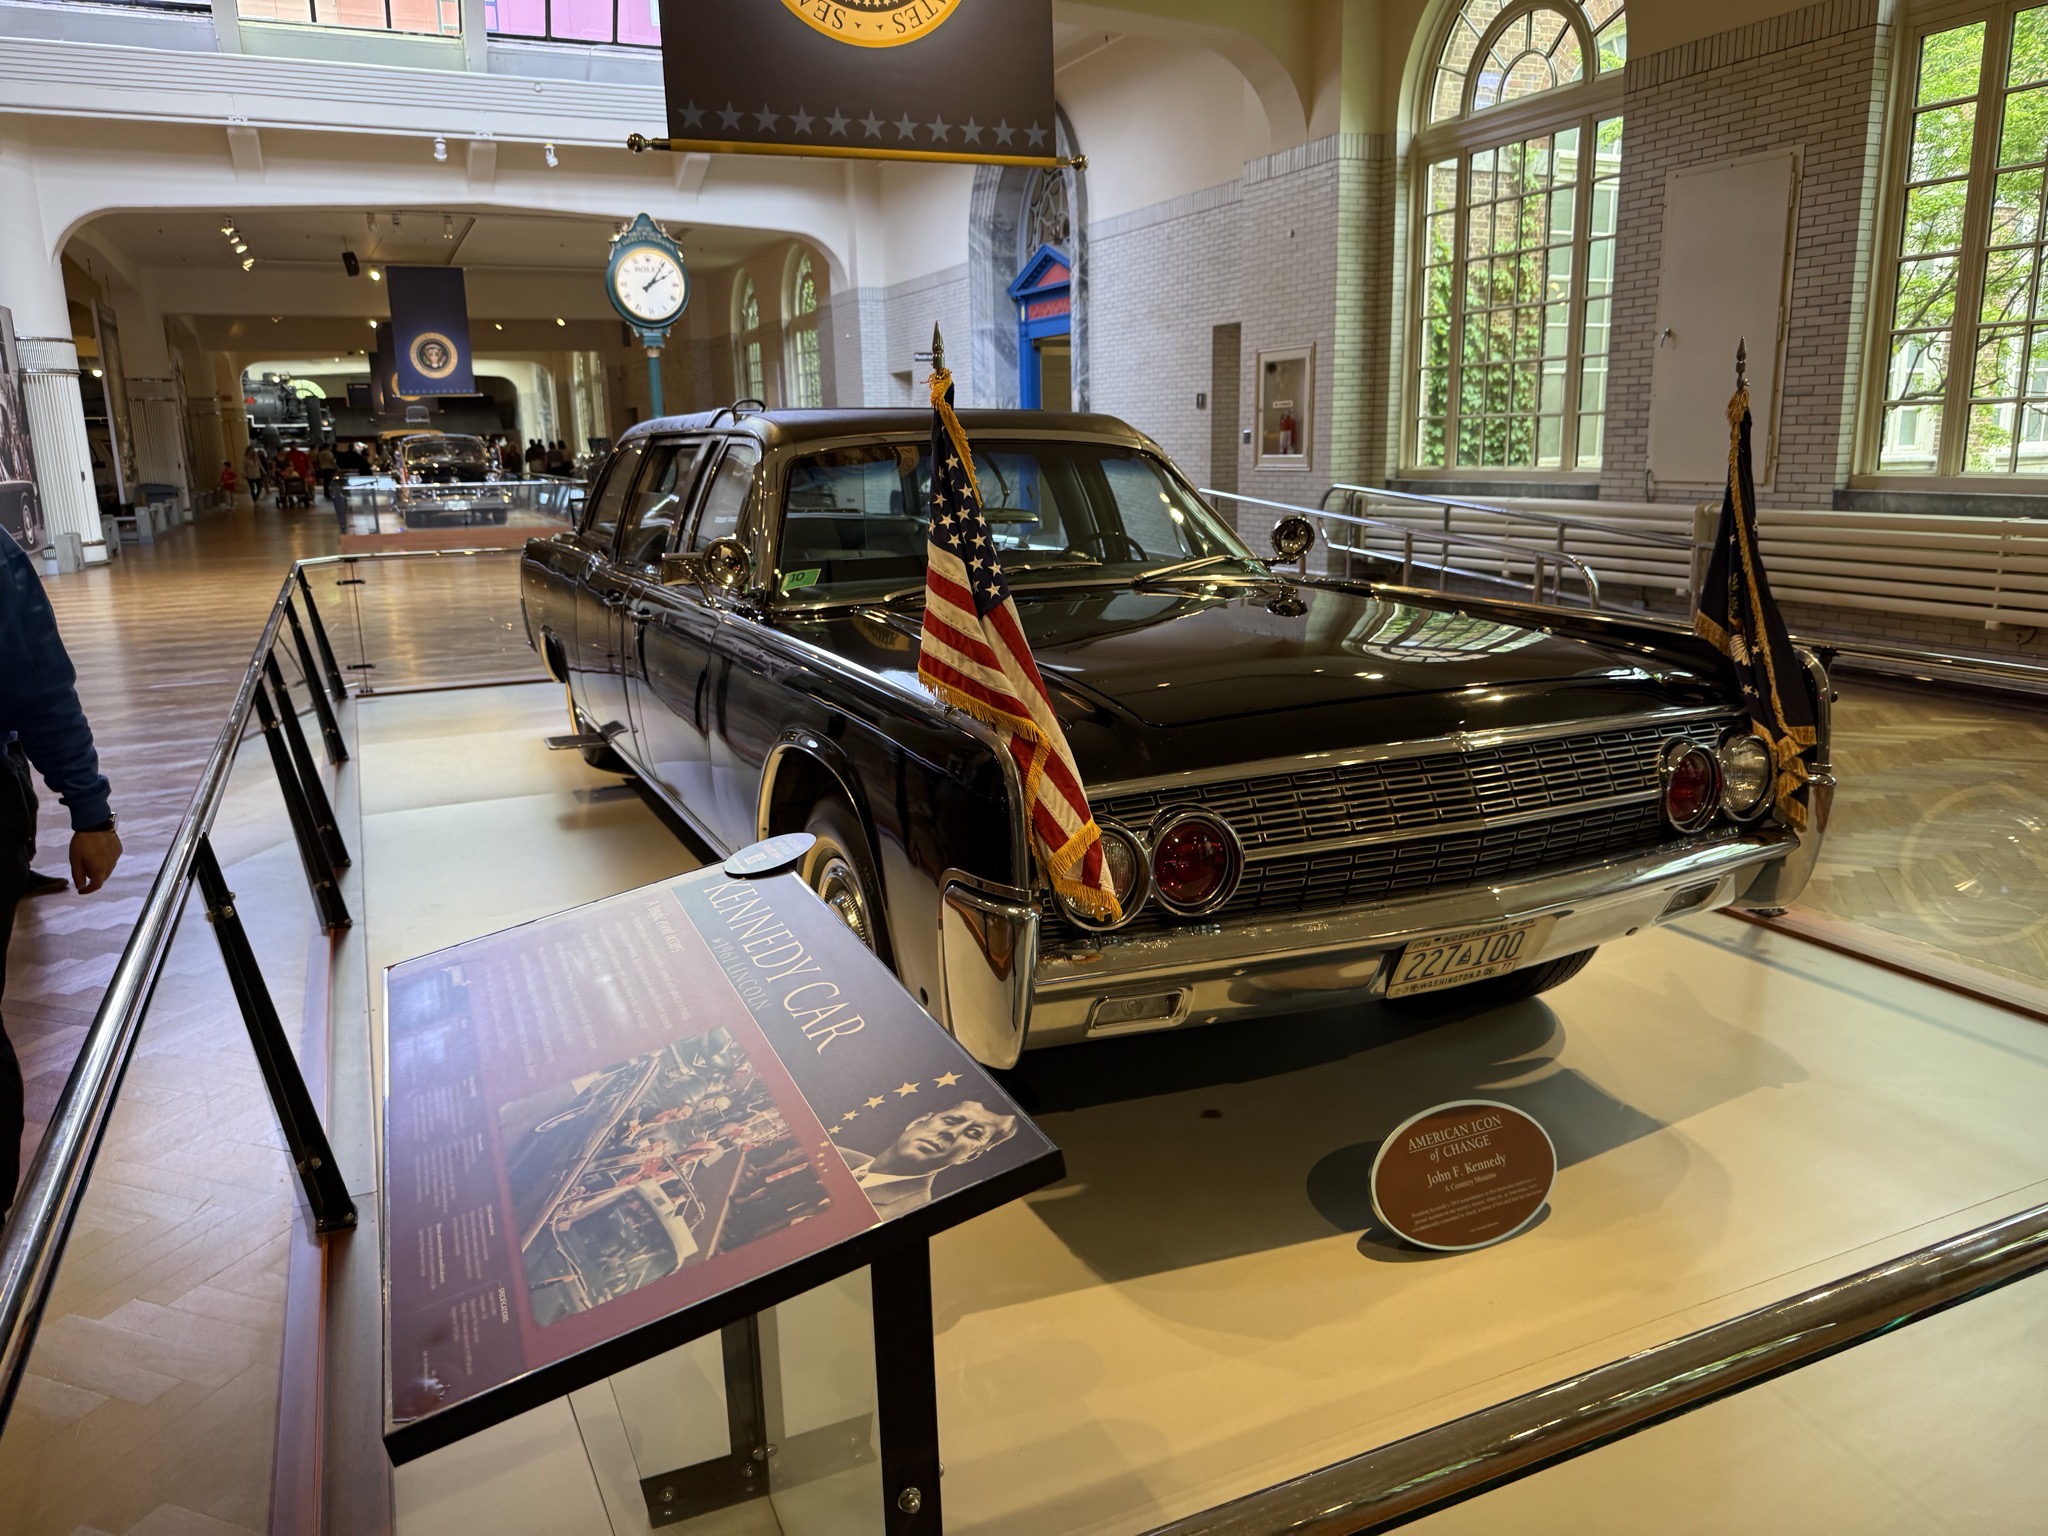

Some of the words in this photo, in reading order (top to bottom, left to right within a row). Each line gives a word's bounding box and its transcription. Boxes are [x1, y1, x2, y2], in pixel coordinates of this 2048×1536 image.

[799, 0, 846, 30] SE
[892, 0, 947, 34] TES
[1443, 924, 1508, 943] BICENTENNIAL
[703, 877, 822, 984] KENNEDY
[783, 981, 866, 1055] CAR
[716, 942, 736, 964] 1961
[726, 962, 774, 1012] LINCOLN
[1408, 1123, 1469, 1151] AMERICAN
[1471, 1114, 1502, 1132] ICON
[1430, 1147, 1439, 1163] of
[1442, 1135, 1492, 1158] CHANGE
[1427, 1170, 1452, 1189] John
[1452, 1165, 1464, 1178] F.
[1464, 1153, 1506, 1174] Kennedy
[1450, 1178, 1474, 1191] Country
